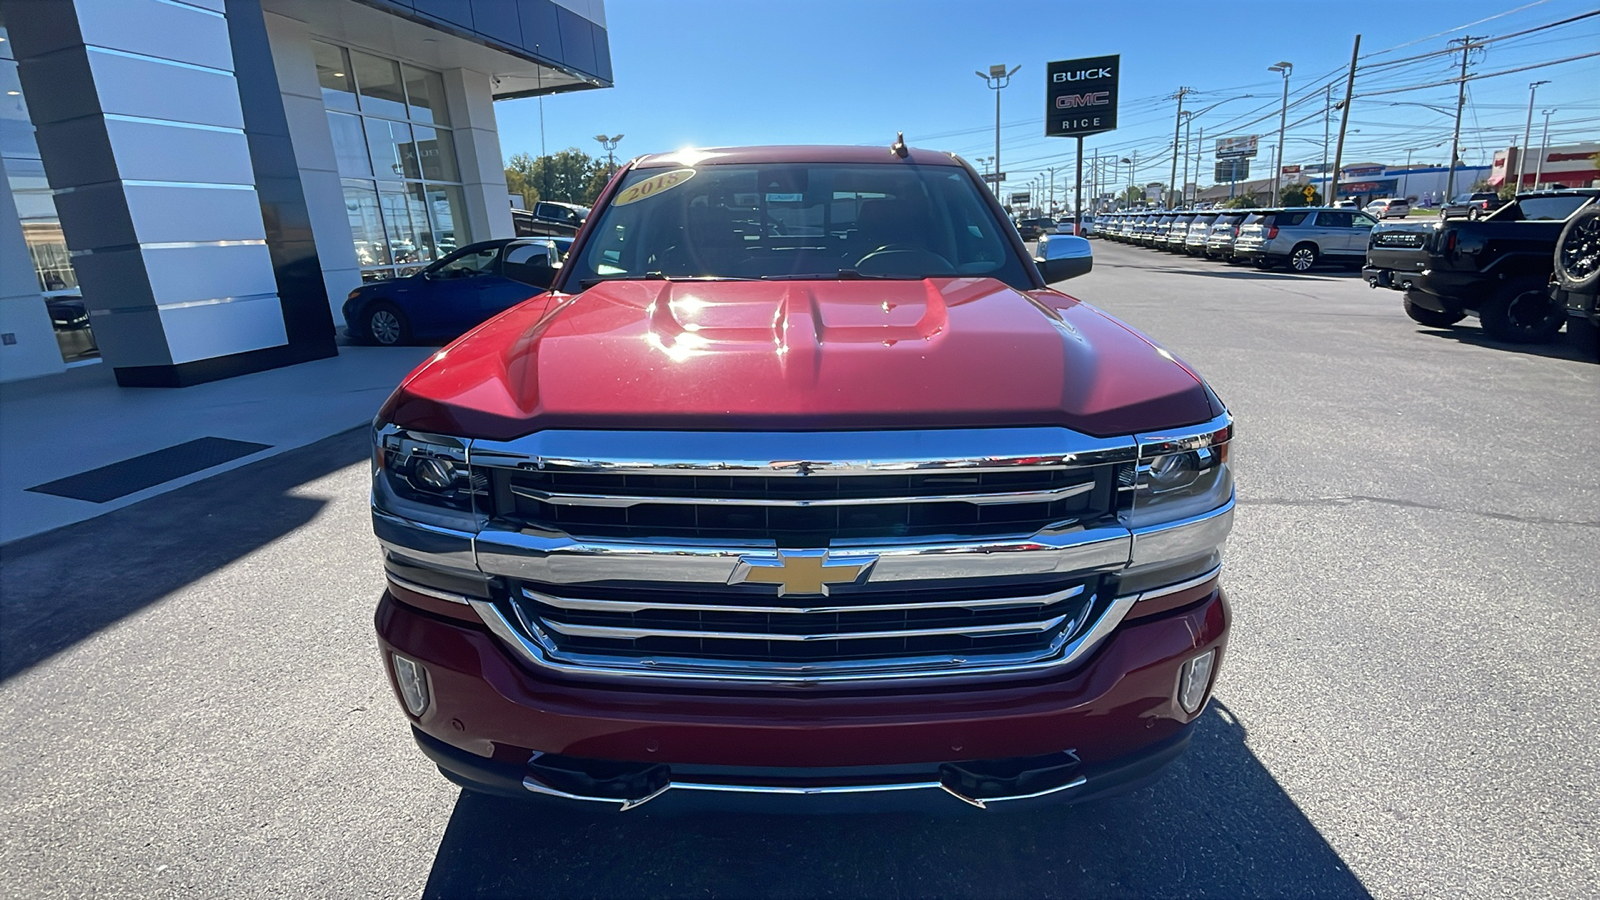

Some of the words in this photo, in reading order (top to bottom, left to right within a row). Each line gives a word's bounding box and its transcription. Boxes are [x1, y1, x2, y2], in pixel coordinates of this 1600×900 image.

[1053, 67, 1112, 83] BUICK
[1055, 91, 1110, 109] GMC
[1062, 117, 1101, 129] RICE
[628, 172, 680, 201] 2018
